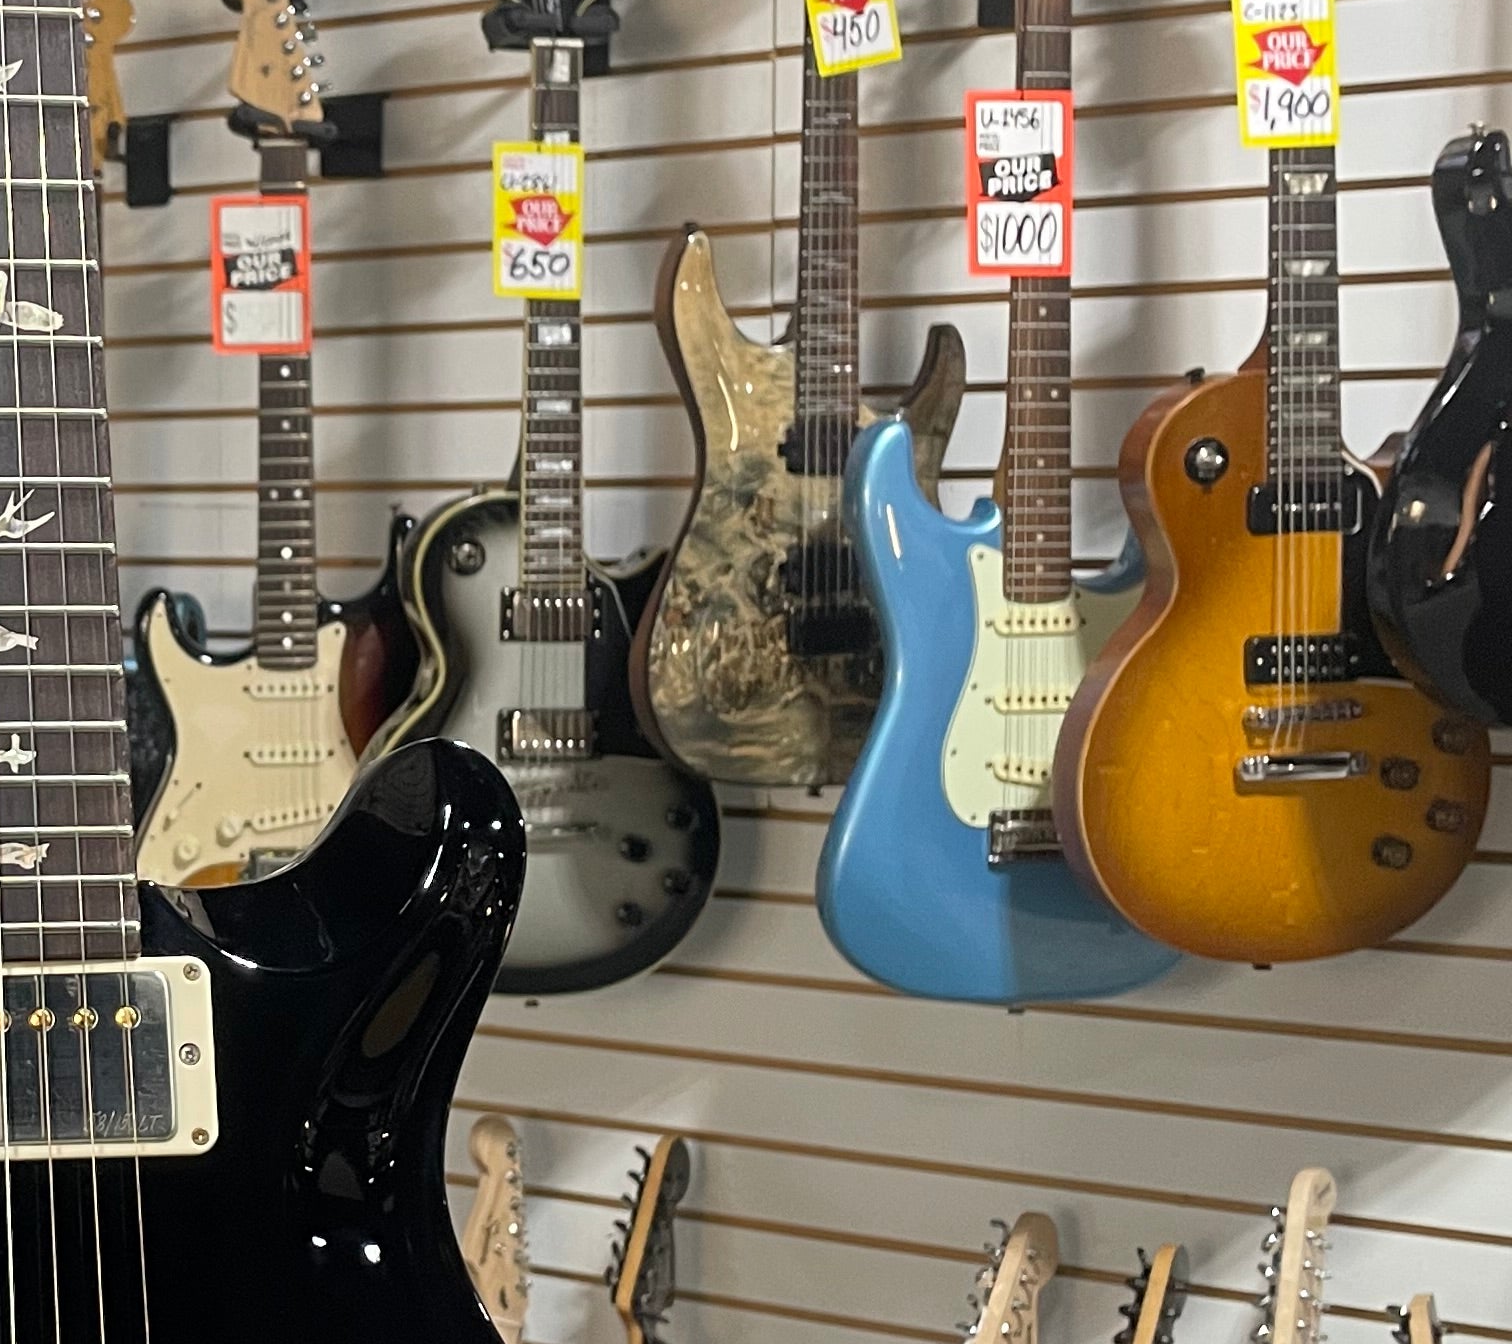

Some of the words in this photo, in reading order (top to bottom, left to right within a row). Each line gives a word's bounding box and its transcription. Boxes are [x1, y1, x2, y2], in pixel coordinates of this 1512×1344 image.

[1266, 31, 1309, 51] OUR
[1261, 49, 1318, 71] PRICE
[993, 155, 1042, 179] OUR
[987, 169, 1054, 198] PRICE
[979, 209, 1059, 261] $1000
[236, 252, 282, 272] OUR
[230, 262, 293, 288] PRICE
